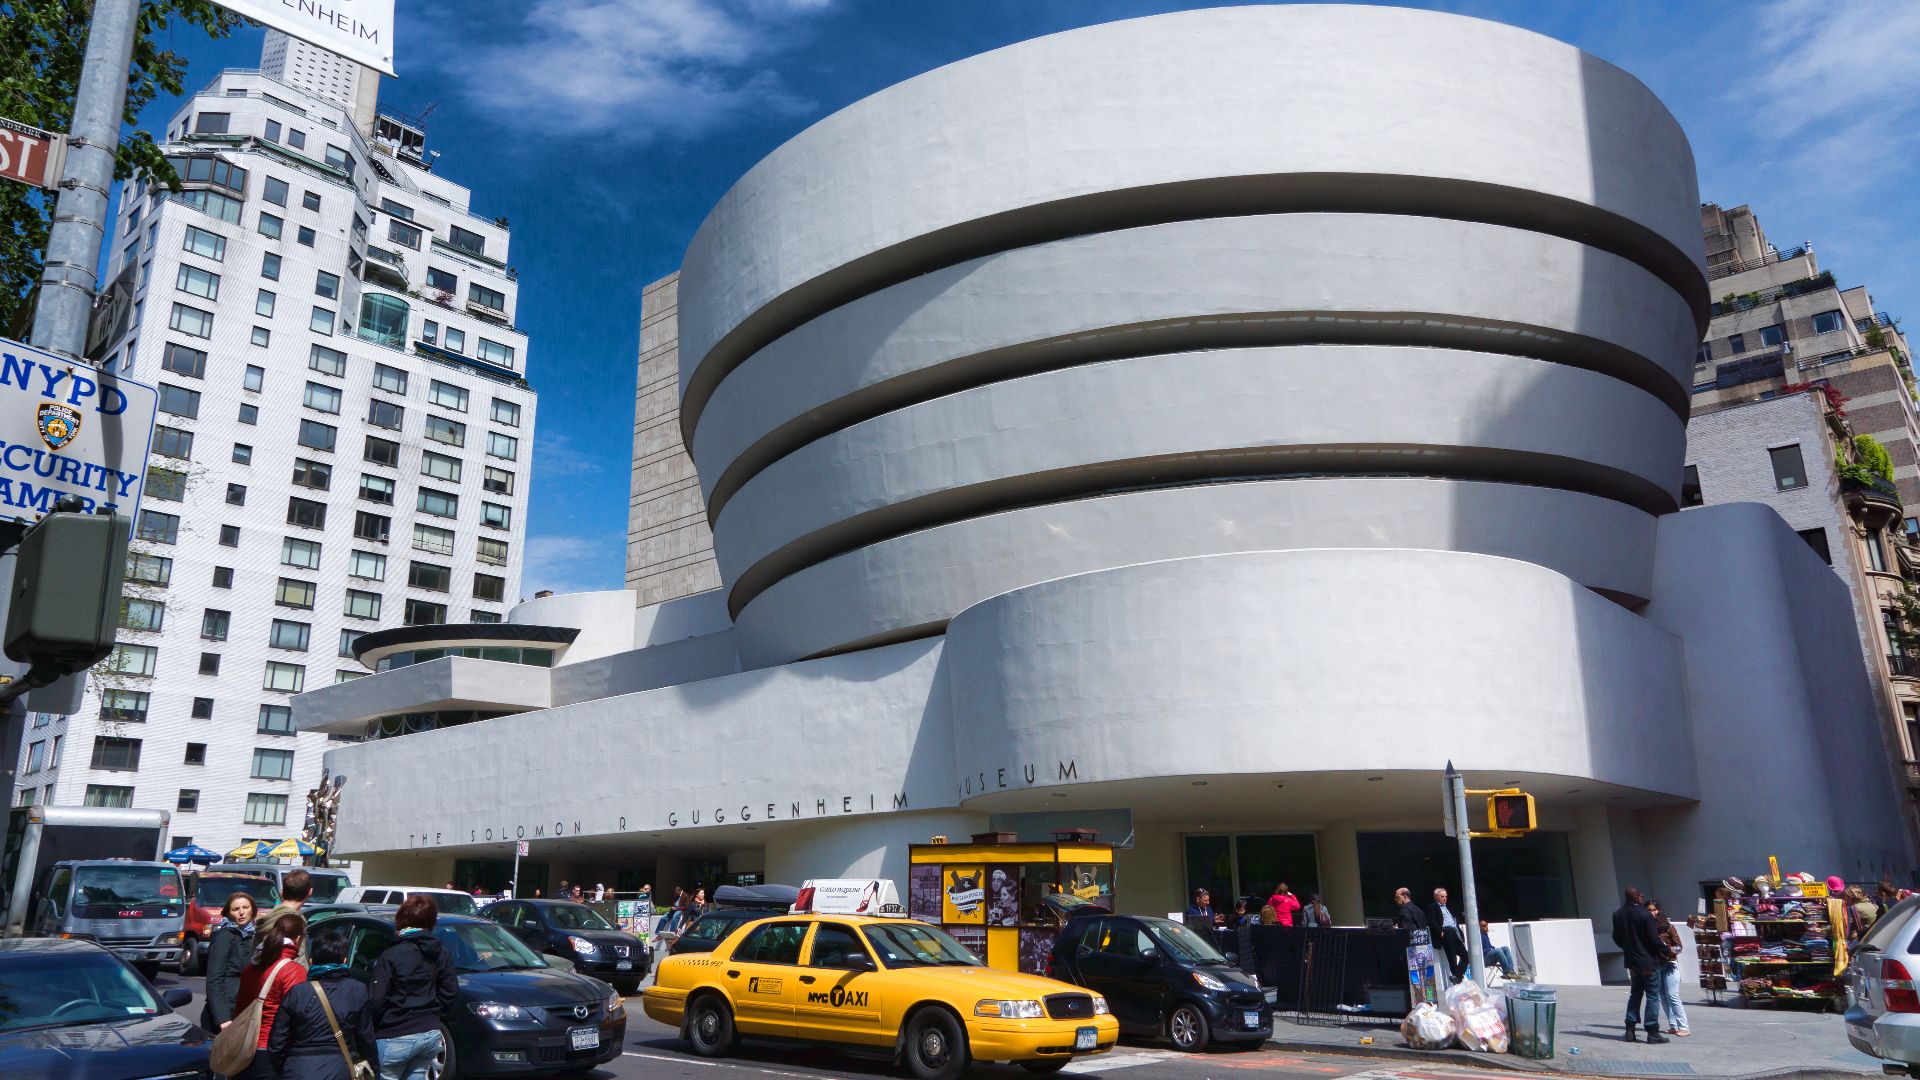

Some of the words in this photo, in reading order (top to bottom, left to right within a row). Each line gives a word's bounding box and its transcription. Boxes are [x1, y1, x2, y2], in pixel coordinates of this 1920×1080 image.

[281, 0, 378, 44] NHEIM
[0, 352, 128, 416] NYPD
[0, 440, 138, 497] CURITY
[0, 477, 119, 515] AMR
[409, 832, 442, 848] THE
[471, 820, 581, 843] SOLOMON
[619, 816, 627, 831] R
[668, 791, 908, 827] GUGGENHEIM
[807, 991, 829, 1004] NYC
[831, 986, 869, 1007] TAXI
